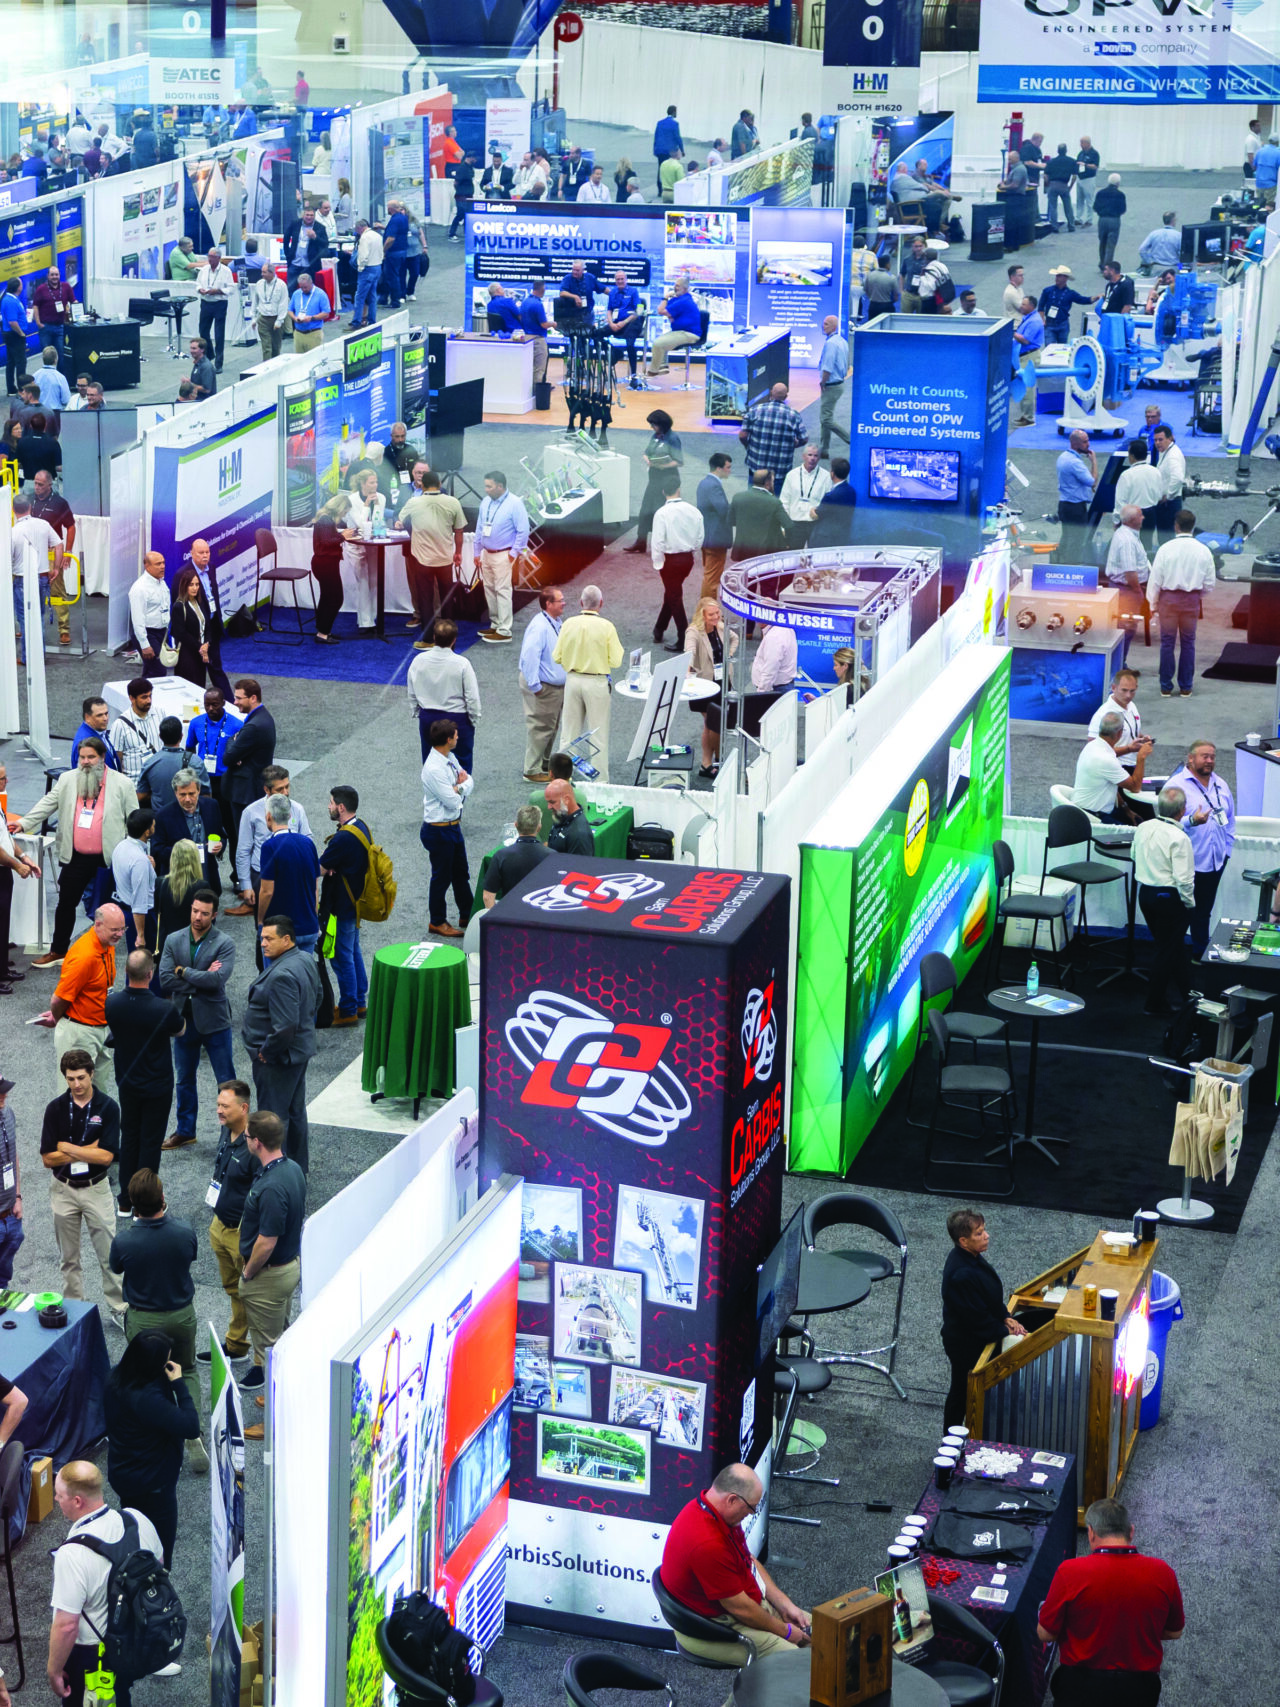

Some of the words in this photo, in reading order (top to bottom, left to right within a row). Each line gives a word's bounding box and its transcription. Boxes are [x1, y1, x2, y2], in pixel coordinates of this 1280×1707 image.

[182, 10, 202, 34] 0
[862, 15, 884, 41] 0
[1043, 25, 1153, 33] ENGINEERED
[1083, 44, 1090, 53] a
[1101, 43, 1133, 54] DOVER
[1141, 42, 1197, 56] company
[178, 68, 221, 81] ATEC
[852, 73, 888, 91] H+M
[1019, 77, 1136, 91] ENGINEERING
[1149, 77, 1212, 91] WHAT'S
[1218, 77, 1261, 91] NEXT
[197, 93, 219, 101] #1515
[837, 103, 872, 111] BOOTH
[875, 104, 902, 112] #1620
[486, 202, 517, 213] Lexicon
[473, 222, 504, 235] ONE
[506, 223, 583, 237] COMPANY.
[473, 236, 548, 250] MULTIPLE
[552, 238, 646, 253] SOLUTIONS.
[869, 383, 905, 396] When
[909, 385, 919, 396] It
[922, 386, 968, 399] Counts,
[886, 398, 951, 411] Customers
[872, 411, 909, 423] Count
[912, 414, 928, 424] on
[932, 413, 963, 425] OPW
[857, 424, 927, 437] Engineered
[930, 426, 981, 440] Systems
[722, 588, 750, 615] MERICAN
[750, 603, 777, 622] TANK
[777, 613, 787, 624] &
[787, 613, 835, 630] VESSEL
[831, 635, 852, 643] MOST
[631, 871, 744, 933] CARBIS
[644, 897, 670, 912] Sam
[699, 907, 737, 935] Solutions
[740, 875, 764, 889] LLC
[746, 1099, 759, 1123] Sam
[730, 1081, 782, 1187] CARBIS
[730, 1168, 755, 1209] Solutions
[771, 1126, 781, 1152] LLC
[505, 1544, 651, 1585] arbisSolutions.
